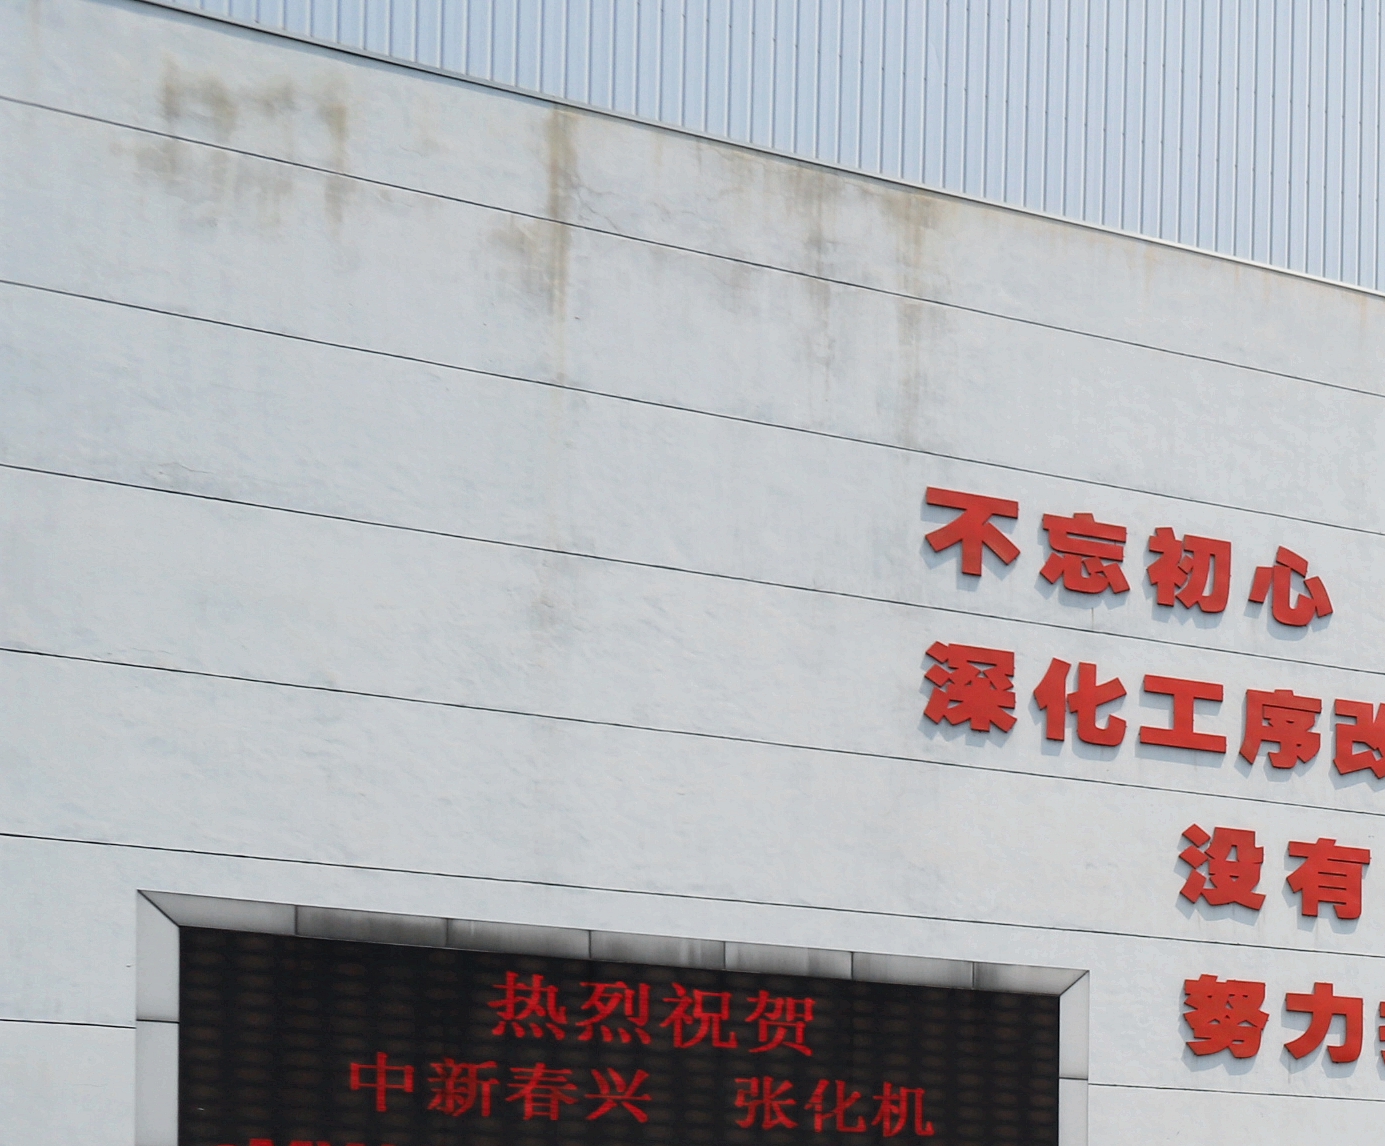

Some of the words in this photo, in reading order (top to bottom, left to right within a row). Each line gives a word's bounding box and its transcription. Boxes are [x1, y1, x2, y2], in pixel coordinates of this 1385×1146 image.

[926, 488, 1331, 625] 不忘初心
[488, 971, 816, 1056] 热烈祝贺
[350, 1053, 651, 1122] 中新春兴
[734, 1076, 934, 1136] 张化机
